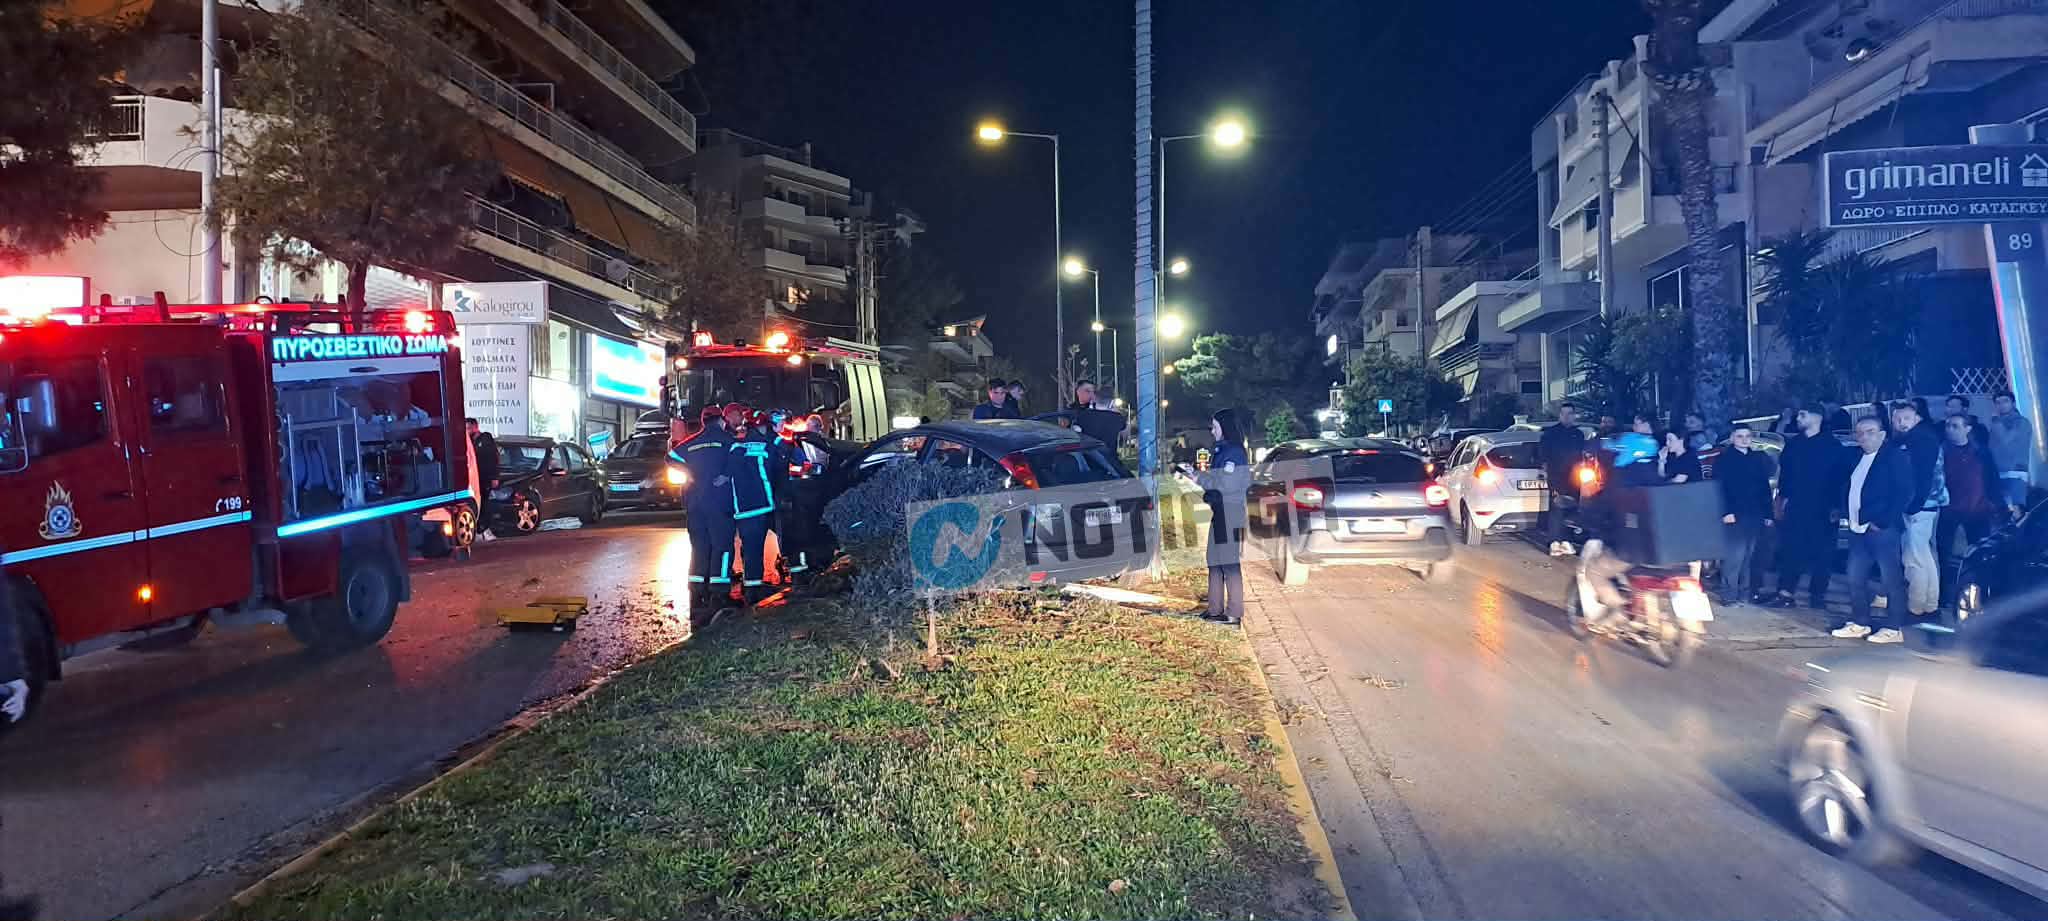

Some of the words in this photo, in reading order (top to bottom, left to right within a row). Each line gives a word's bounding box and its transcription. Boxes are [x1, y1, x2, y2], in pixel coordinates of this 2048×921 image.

[1844, 157, 2010, 199] grimaneli
[1842, 207, 1885, 219] ΔΩΡΟ
[1895, 203, 1959, 217] ΕΠΙΠΛΟ
[2008, 233, 2032, 250] 89
[473, 298, 533, 316] Kalogirou
[272, 335, 403, 360] ΠΥΡΟΣΒΕΣΤΙΚΟ
[405, 335, 448, 353] ΣΩΜΑ
[224, 496, 242, 510] 199
